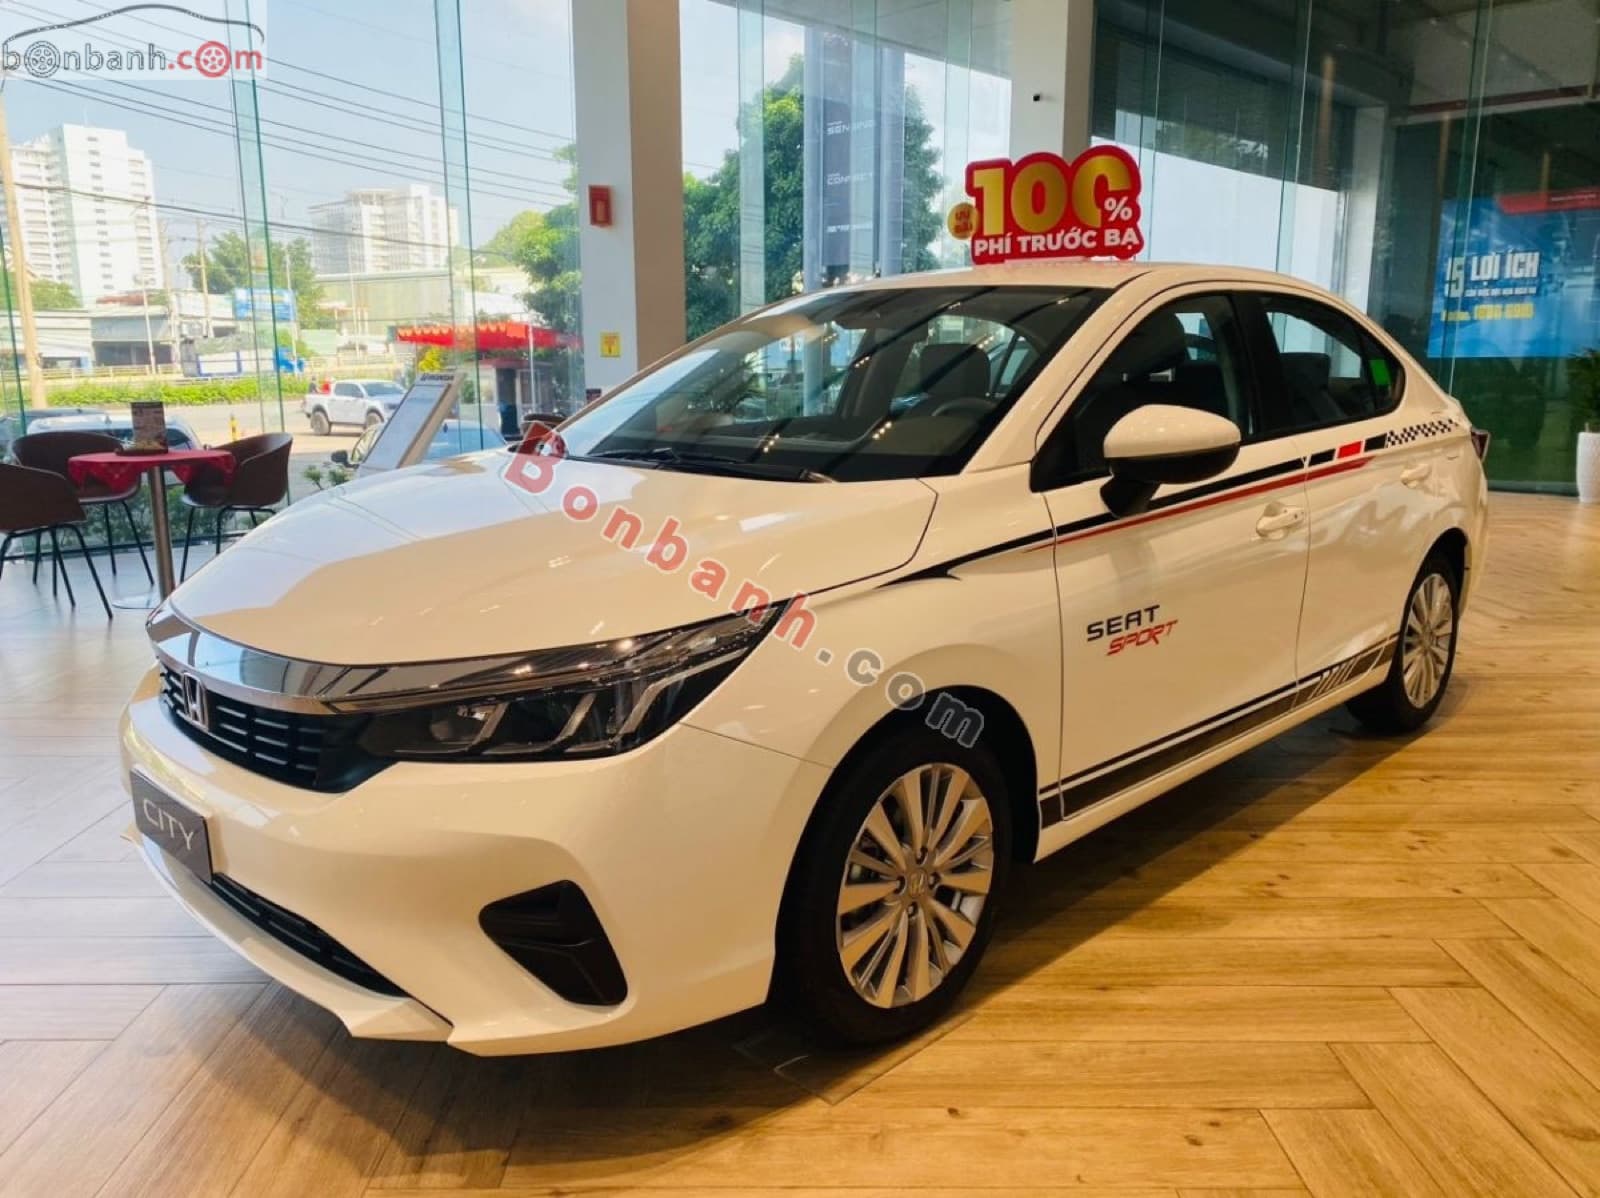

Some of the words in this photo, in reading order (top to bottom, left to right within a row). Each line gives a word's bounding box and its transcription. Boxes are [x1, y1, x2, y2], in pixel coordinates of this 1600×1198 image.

[974, 232, 1012, 257] PHÍ
[1017, 226, 1097, 253] TRƯỚC
[1104, 227, 1140, 250] BẠ
[1086, 604, 1160, 642] SEAT
[1105, 618, 1179, 656] SPORT
[143, 797, 195, 851] CITY
